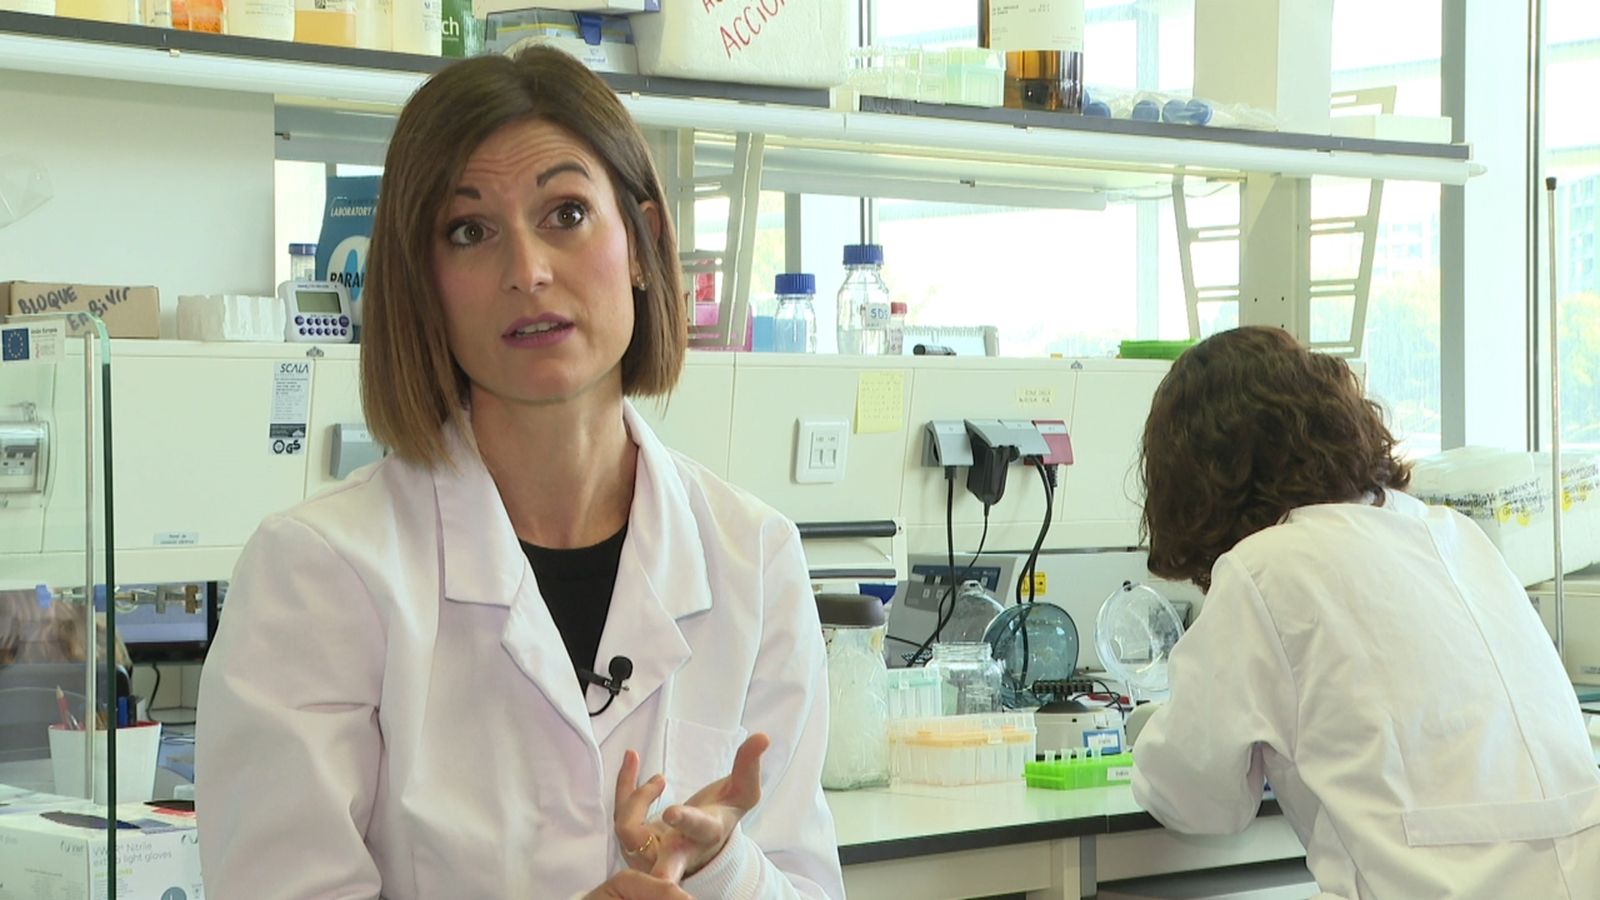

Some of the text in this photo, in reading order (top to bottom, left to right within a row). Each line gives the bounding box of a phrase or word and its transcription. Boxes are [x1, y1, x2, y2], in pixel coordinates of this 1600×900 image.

[330, 205, 371, 217] LABORATORY
[18, 286, 77, 314] BLOQUE
[280, 363, 309, 373] SCALA
[126, 842, 152, 852] Nitrile
[93, 850, 172, 867] exta light gloves
